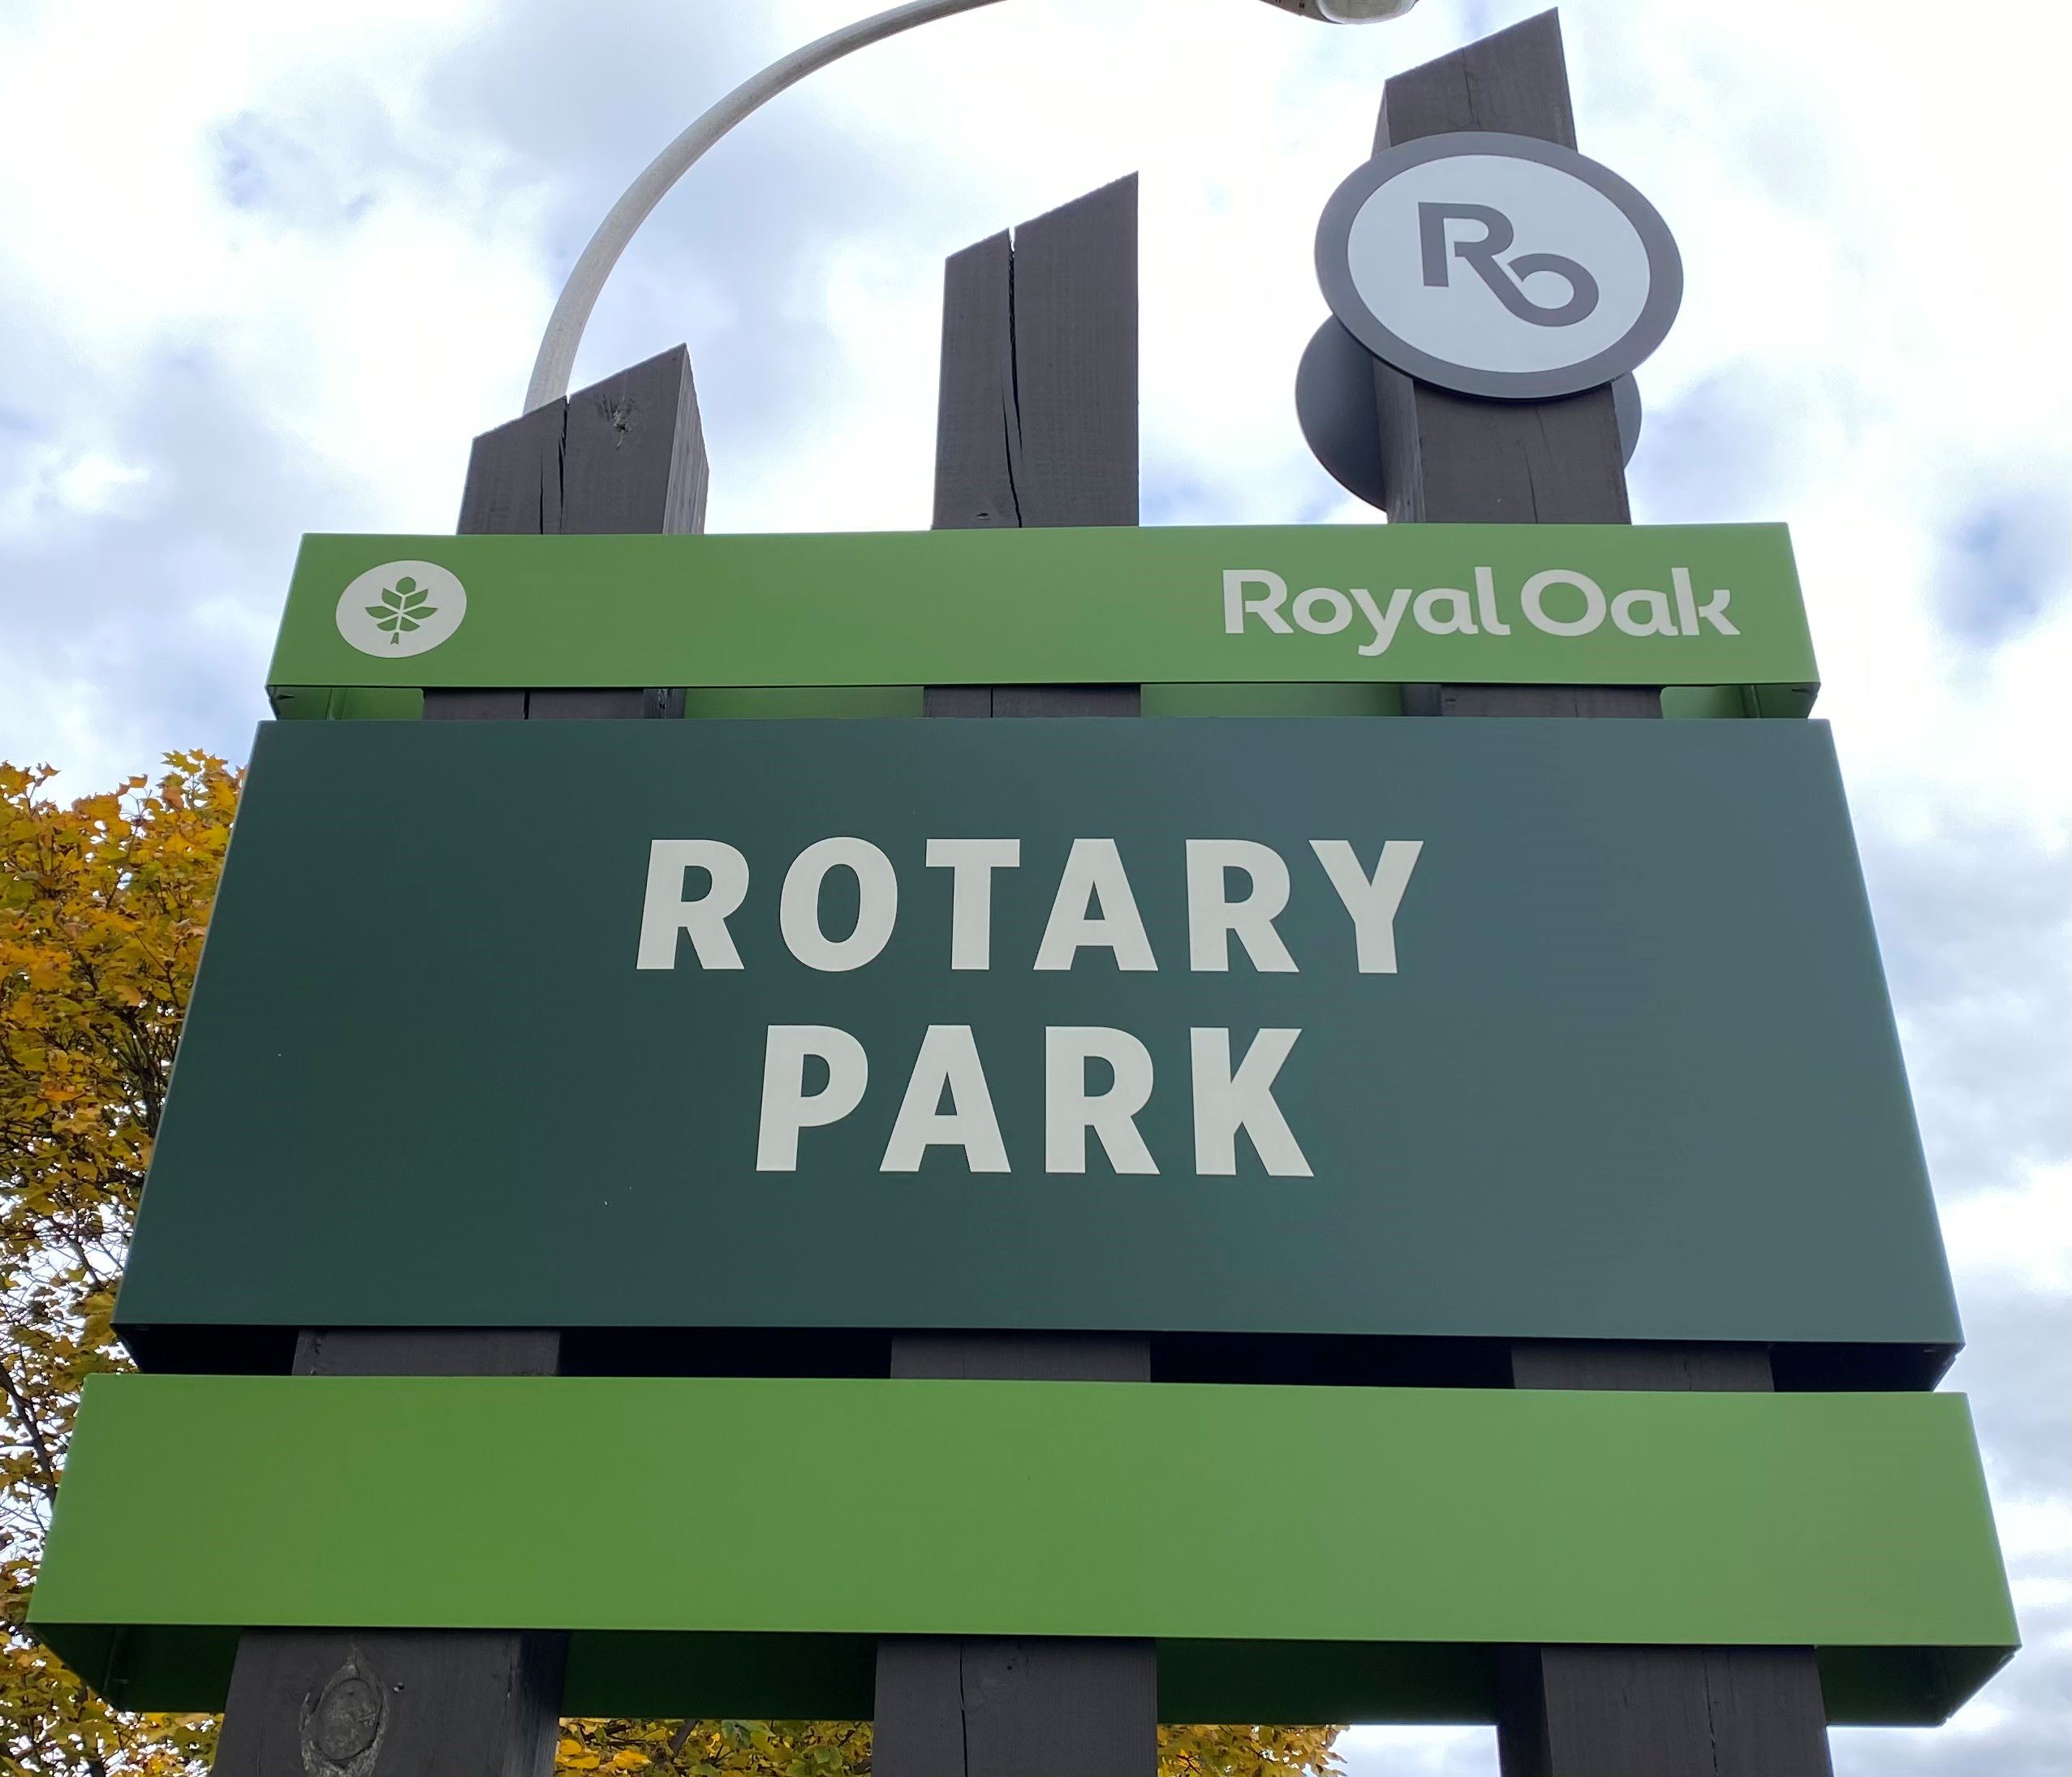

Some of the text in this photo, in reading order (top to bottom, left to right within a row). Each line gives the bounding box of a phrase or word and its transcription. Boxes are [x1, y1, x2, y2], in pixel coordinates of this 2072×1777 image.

[1222, 566, 1741, 656] Royal Oak
[637, 837, 1424, 974] ROTARY
[756, 1025, 1315, 1177] PARK
